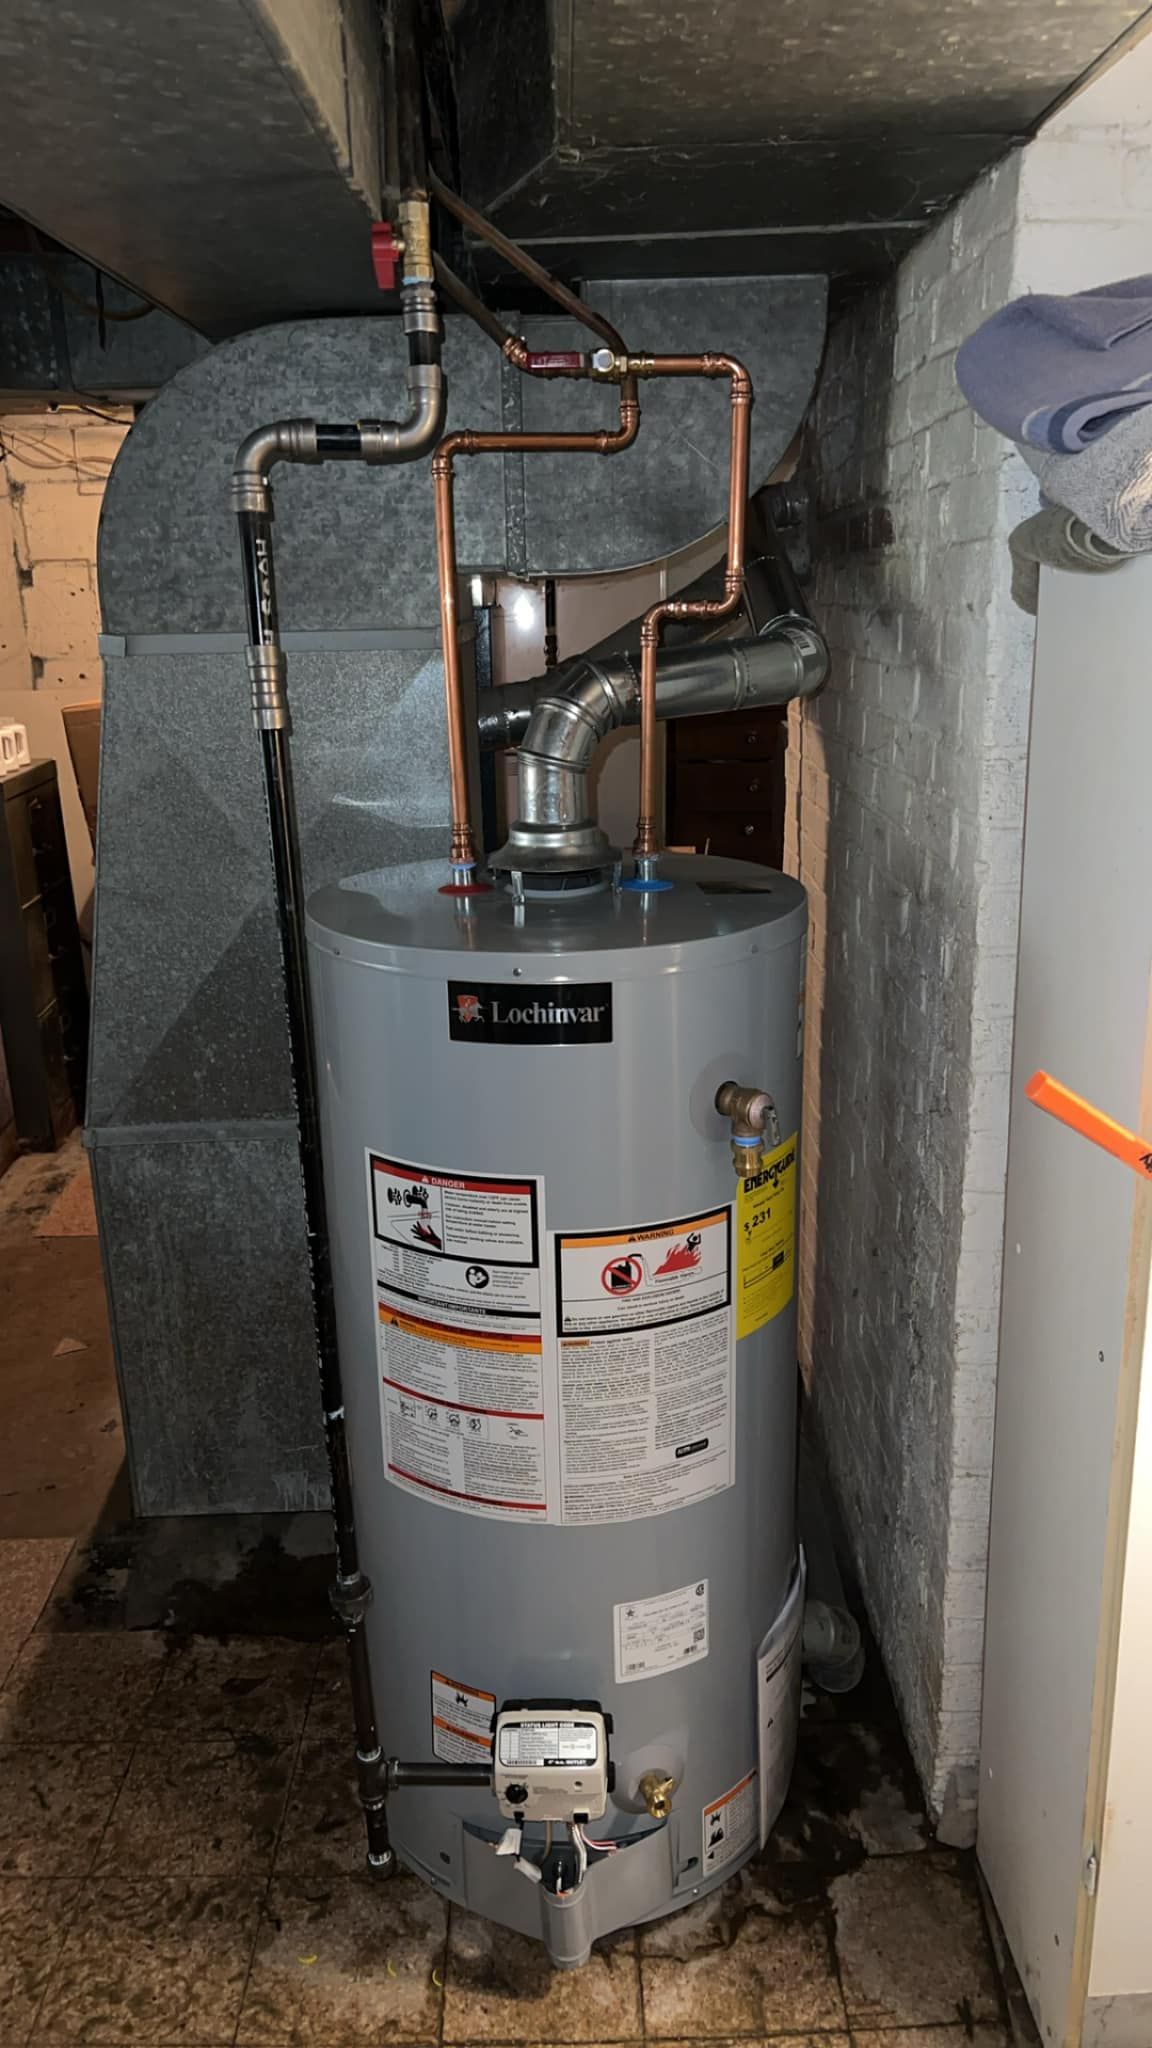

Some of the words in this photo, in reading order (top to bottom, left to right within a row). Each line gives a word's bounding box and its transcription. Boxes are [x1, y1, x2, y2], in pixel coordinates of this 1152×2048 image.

[490, 1001, 605, 1025] Lochinvar
[431, 1177, 465, 1190] DANGER
[636, 1229, 674, 1242] WARNING
